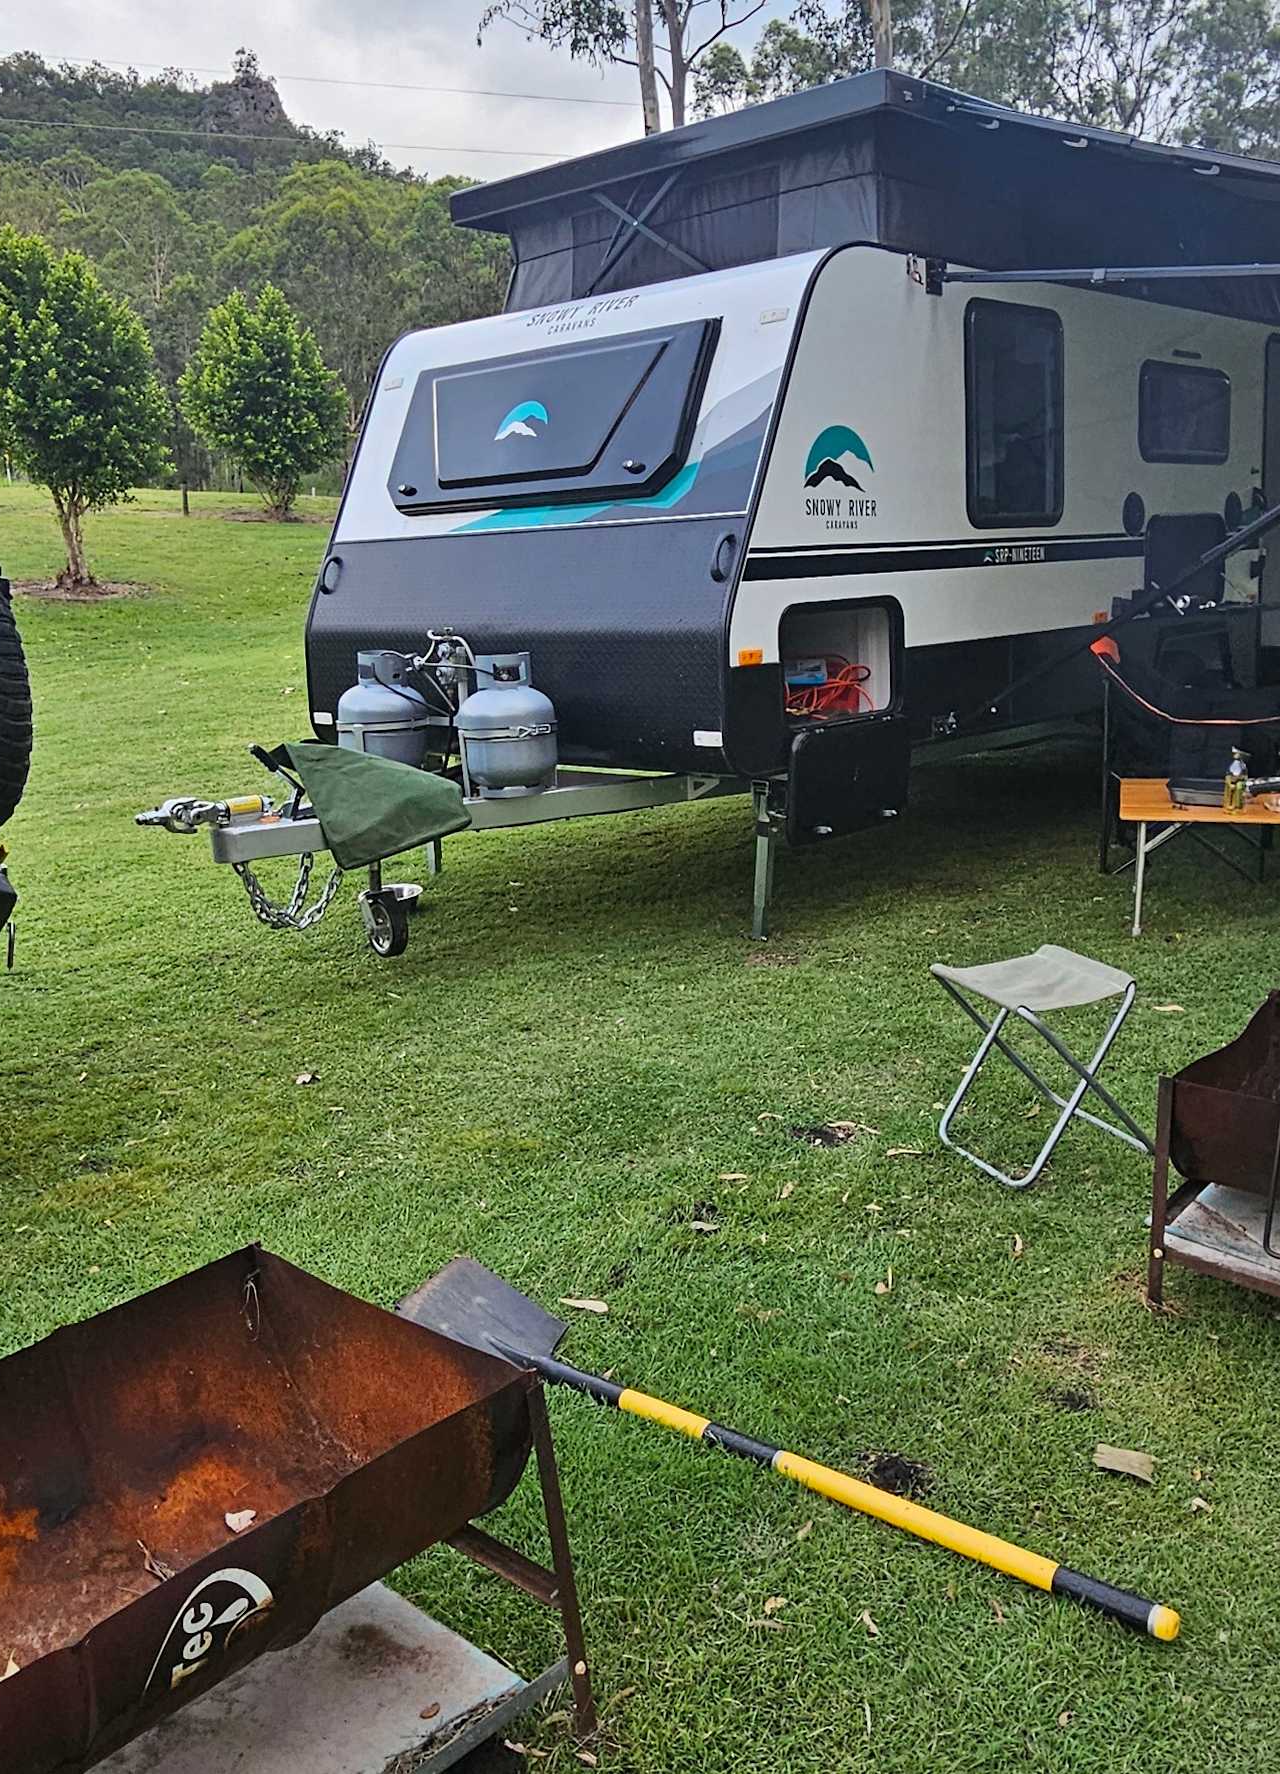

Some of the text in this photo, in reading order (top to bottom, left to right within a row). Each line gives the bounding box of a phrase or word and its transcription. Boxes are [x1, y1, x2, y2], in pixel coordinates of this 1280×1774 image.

[526, 295, 640, 327] SNOWY RIVER
[547, 318, 596, 335] CARAVANS
[805, 498, 877, 516] SNOWY RIVER
[826, 520, 858, 529] CARAVANS
[994, 546, 1045, 563] SRP-NINETEEN
